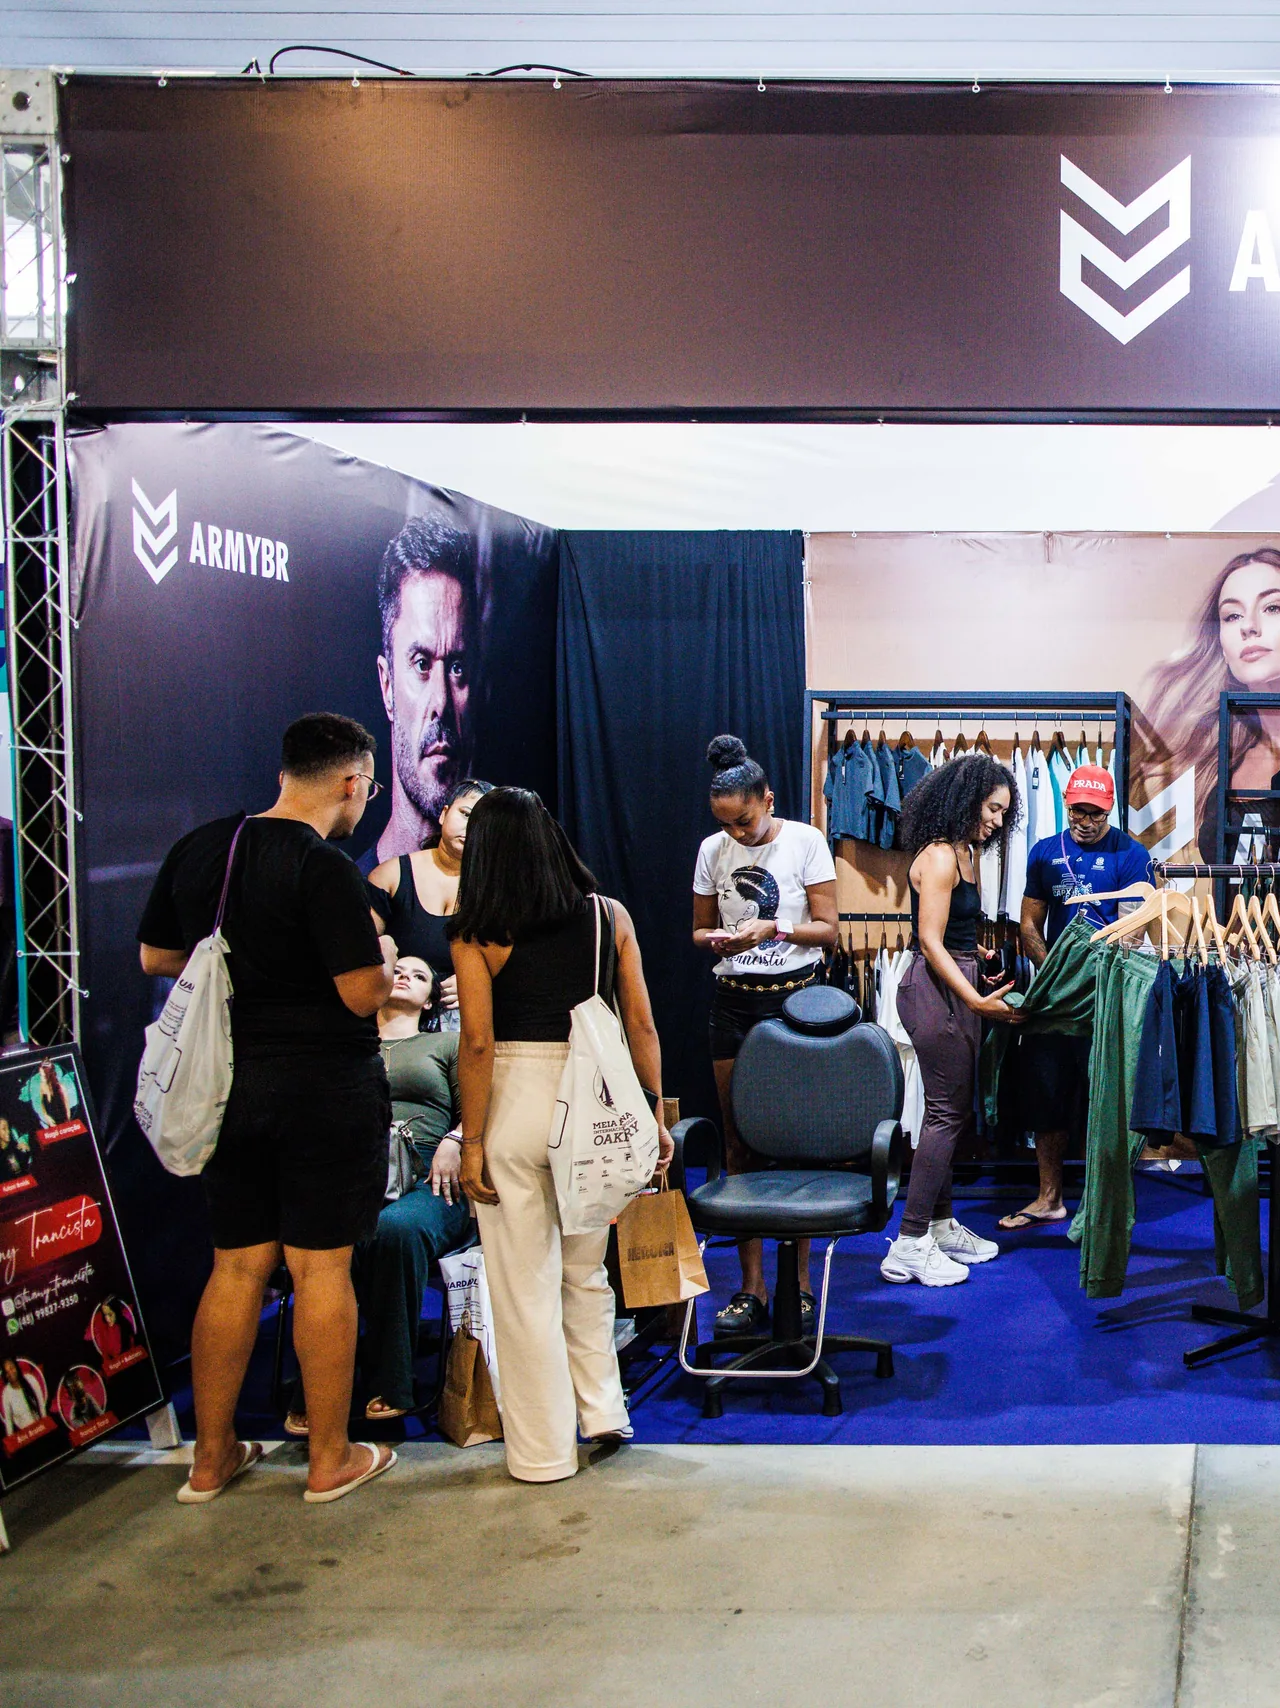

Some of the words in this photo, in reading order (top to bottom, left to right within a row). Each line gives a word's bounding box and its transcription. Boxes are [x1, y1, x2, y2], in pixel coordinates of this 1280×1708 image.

[189, 521, 290, 583] ARMYBR
[1073, 780, 1107, 792] PRADA
[592, 1119, 618, 1130] MEIA
[14, 1197, 101, 1257] Trancista
